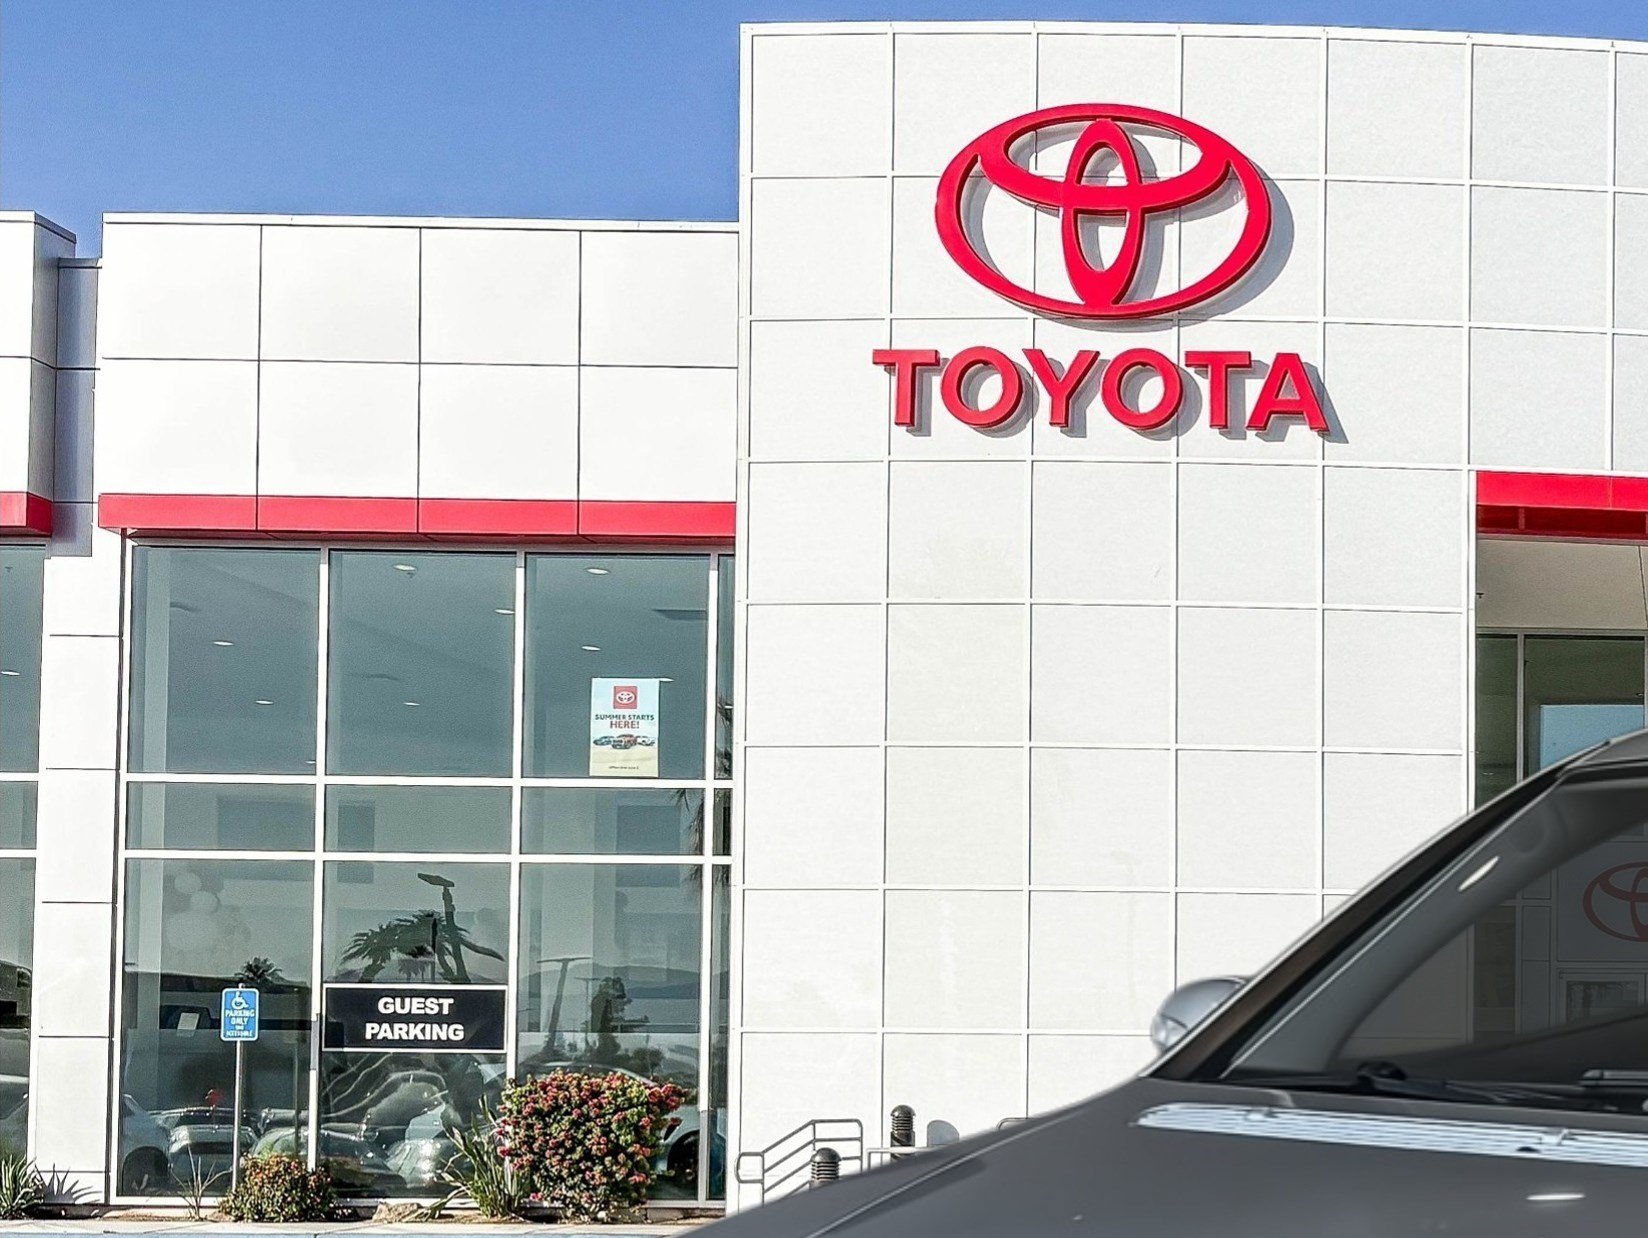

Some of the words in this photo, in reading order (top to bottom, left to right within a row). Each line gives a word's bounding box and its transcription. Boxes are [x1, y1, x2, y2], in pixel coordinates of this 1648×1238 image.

[872, 345, 1329, 434] TOYOTA
[609, 720, 640, 729] HERE!
[377, 997, 455, 1015] GUEST
[224, 1009, 255, 1018] PARKING
[230, 1016, 250, 1025] ONLY
[364, 1022, 465, 1041] PARKING
